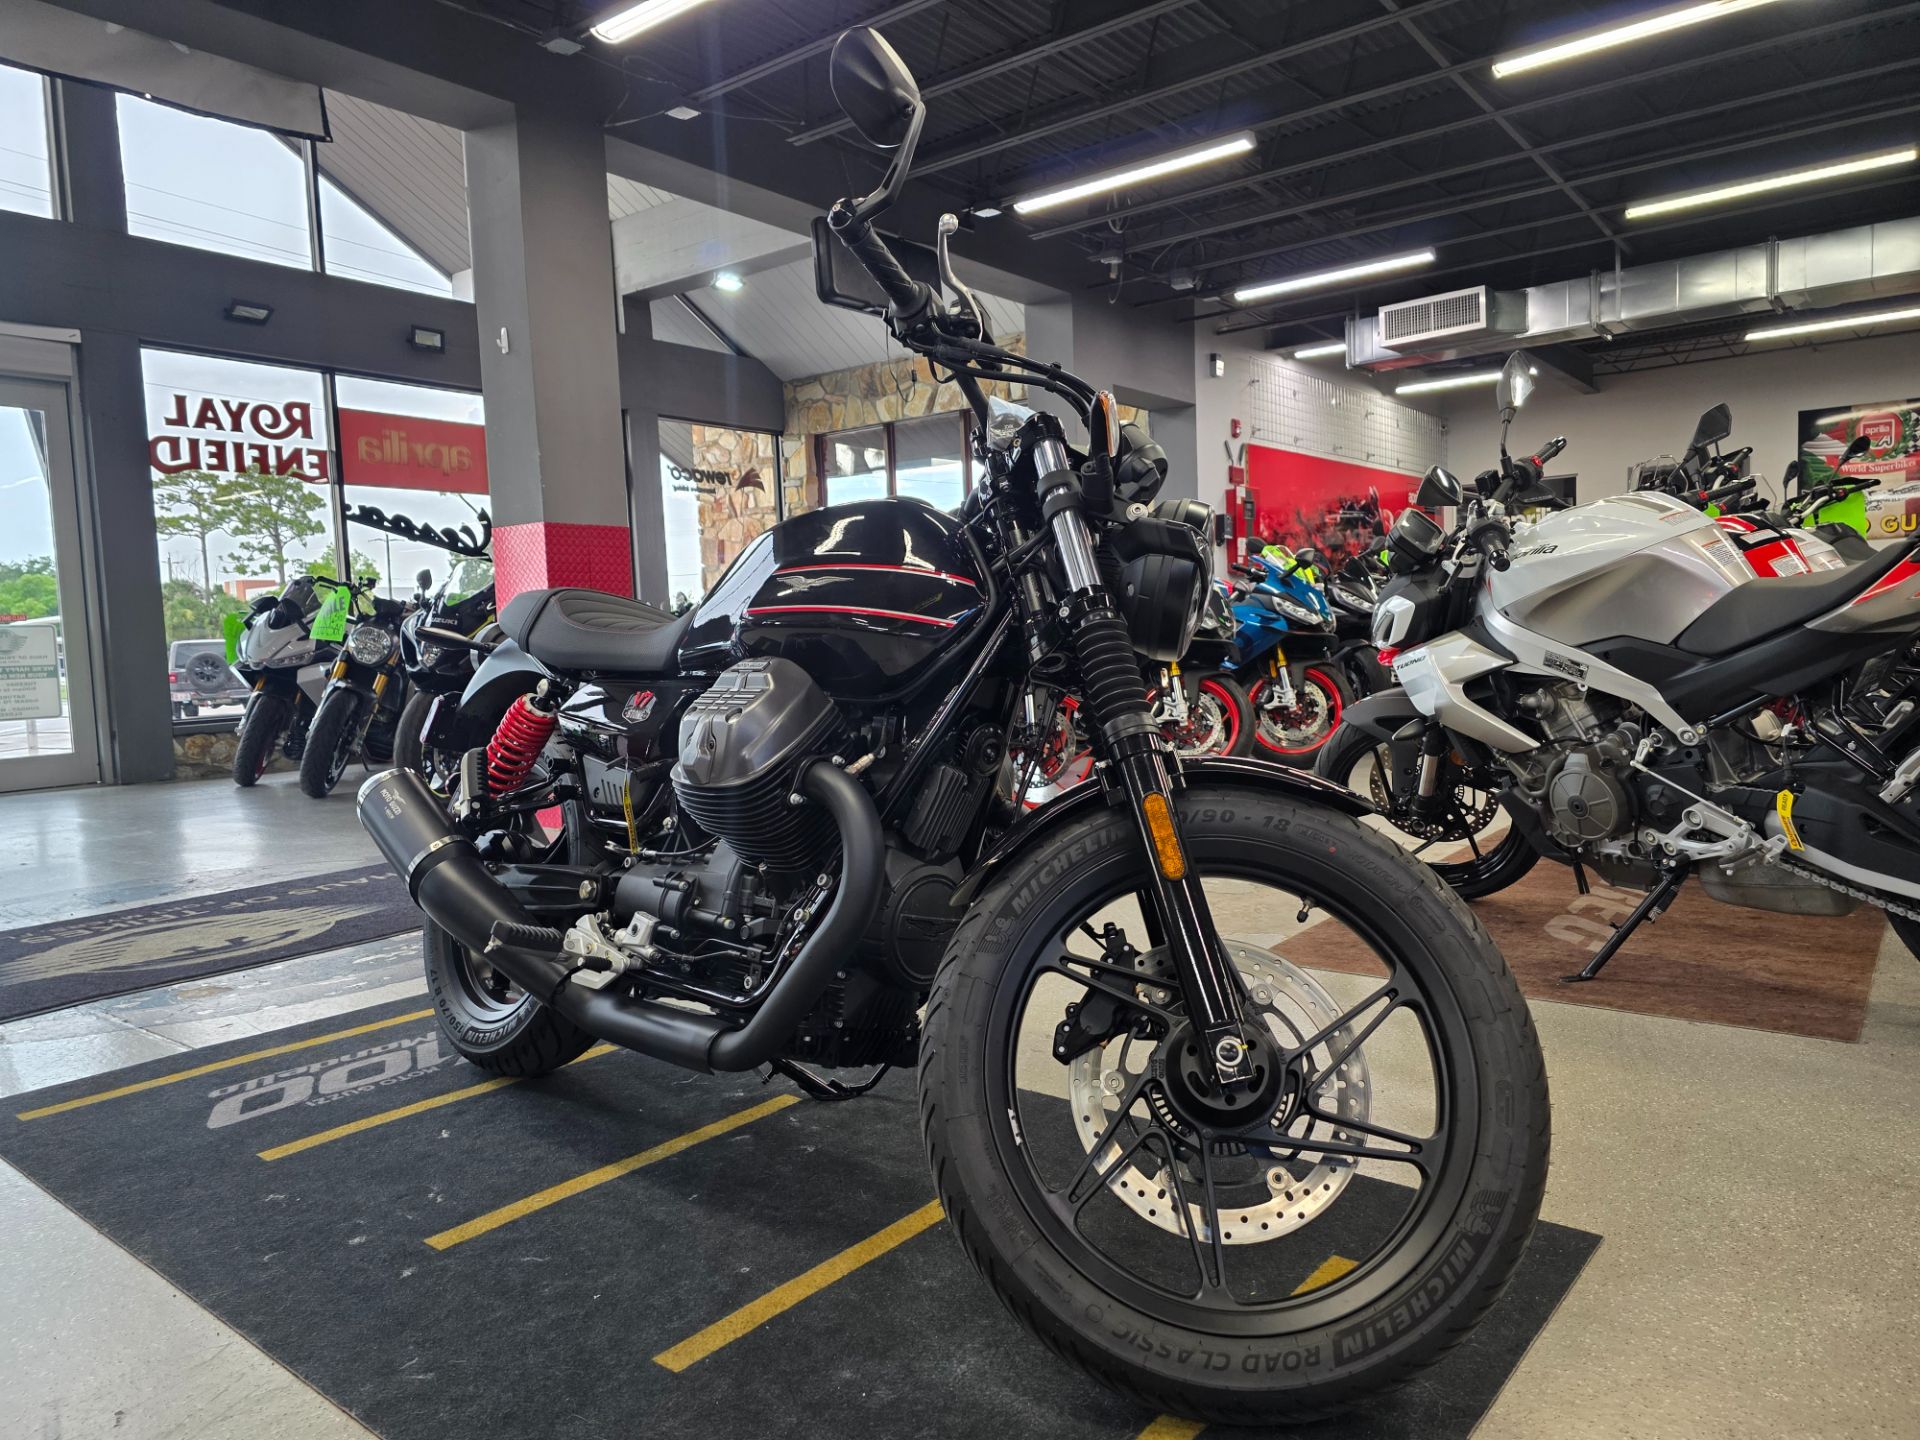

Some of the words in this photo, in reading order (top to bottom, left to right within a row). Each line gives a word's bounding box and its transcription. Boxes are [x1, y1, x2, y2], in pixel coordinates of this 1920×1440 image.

[1865, 423, 1890, 436] aprilia
[1840, 463, 1867, 474] World
[439, 999, 464, 1035] 150/70
[464, 1017, 519, 1044] MICHELIN
[207, 1031, 437, 1098] Mandello
[206, 1040, 470, 1129] 100
[1341, 1238, 1477, 1359] MICHELIN
[1111, 1320, 1232, 1372] CLASSIC
[1242, 1345, 1321, 1374] ROAD
